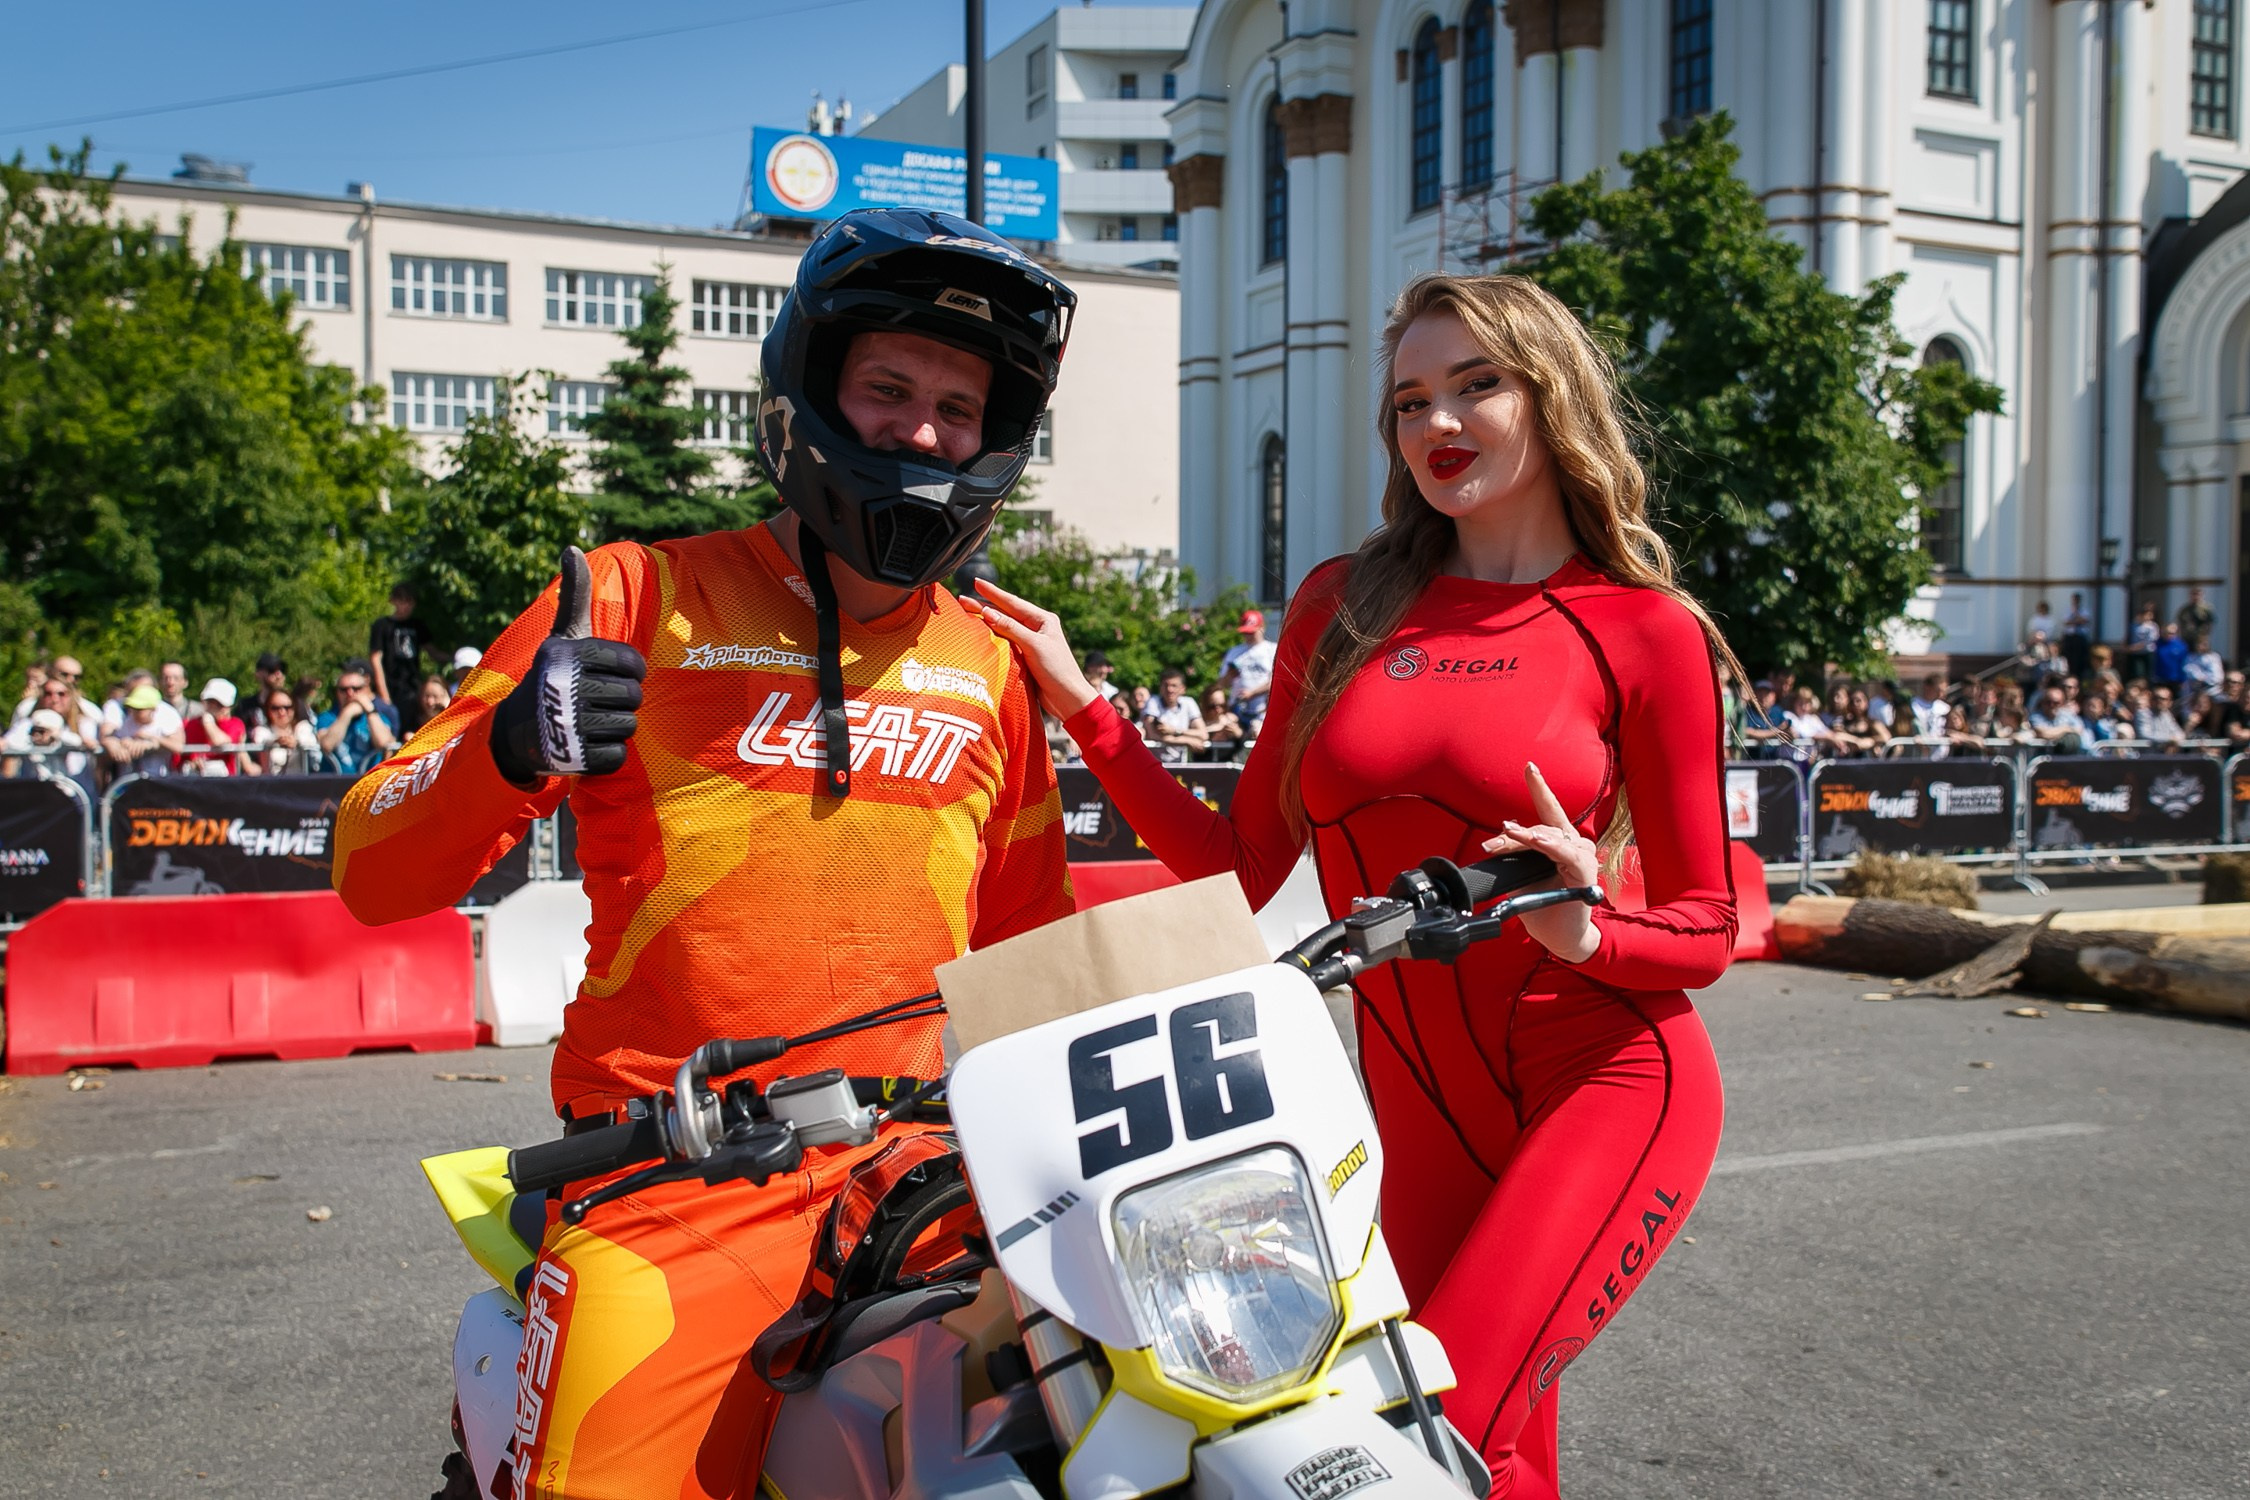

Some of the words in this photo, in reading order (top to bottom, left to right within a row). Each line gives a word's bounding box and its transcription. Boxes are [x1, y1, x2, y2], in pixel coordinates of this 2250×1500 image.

[947, 293, 984, 310] LEATT
[1430, 675, 1457, 684] MOTO
[1458, 673, 1514, 683] LUBRICANTS
[1433, 657, 1519, 674] SEGAL
[543, 671, 572, 764] LEATT
[737, 691, 983, 785] LEATT
[1068, 991, 1275, 1180] 56
[1587, 1187, 1682, 1332] SEGAL
[500, 1308, 518, 1319] TE
